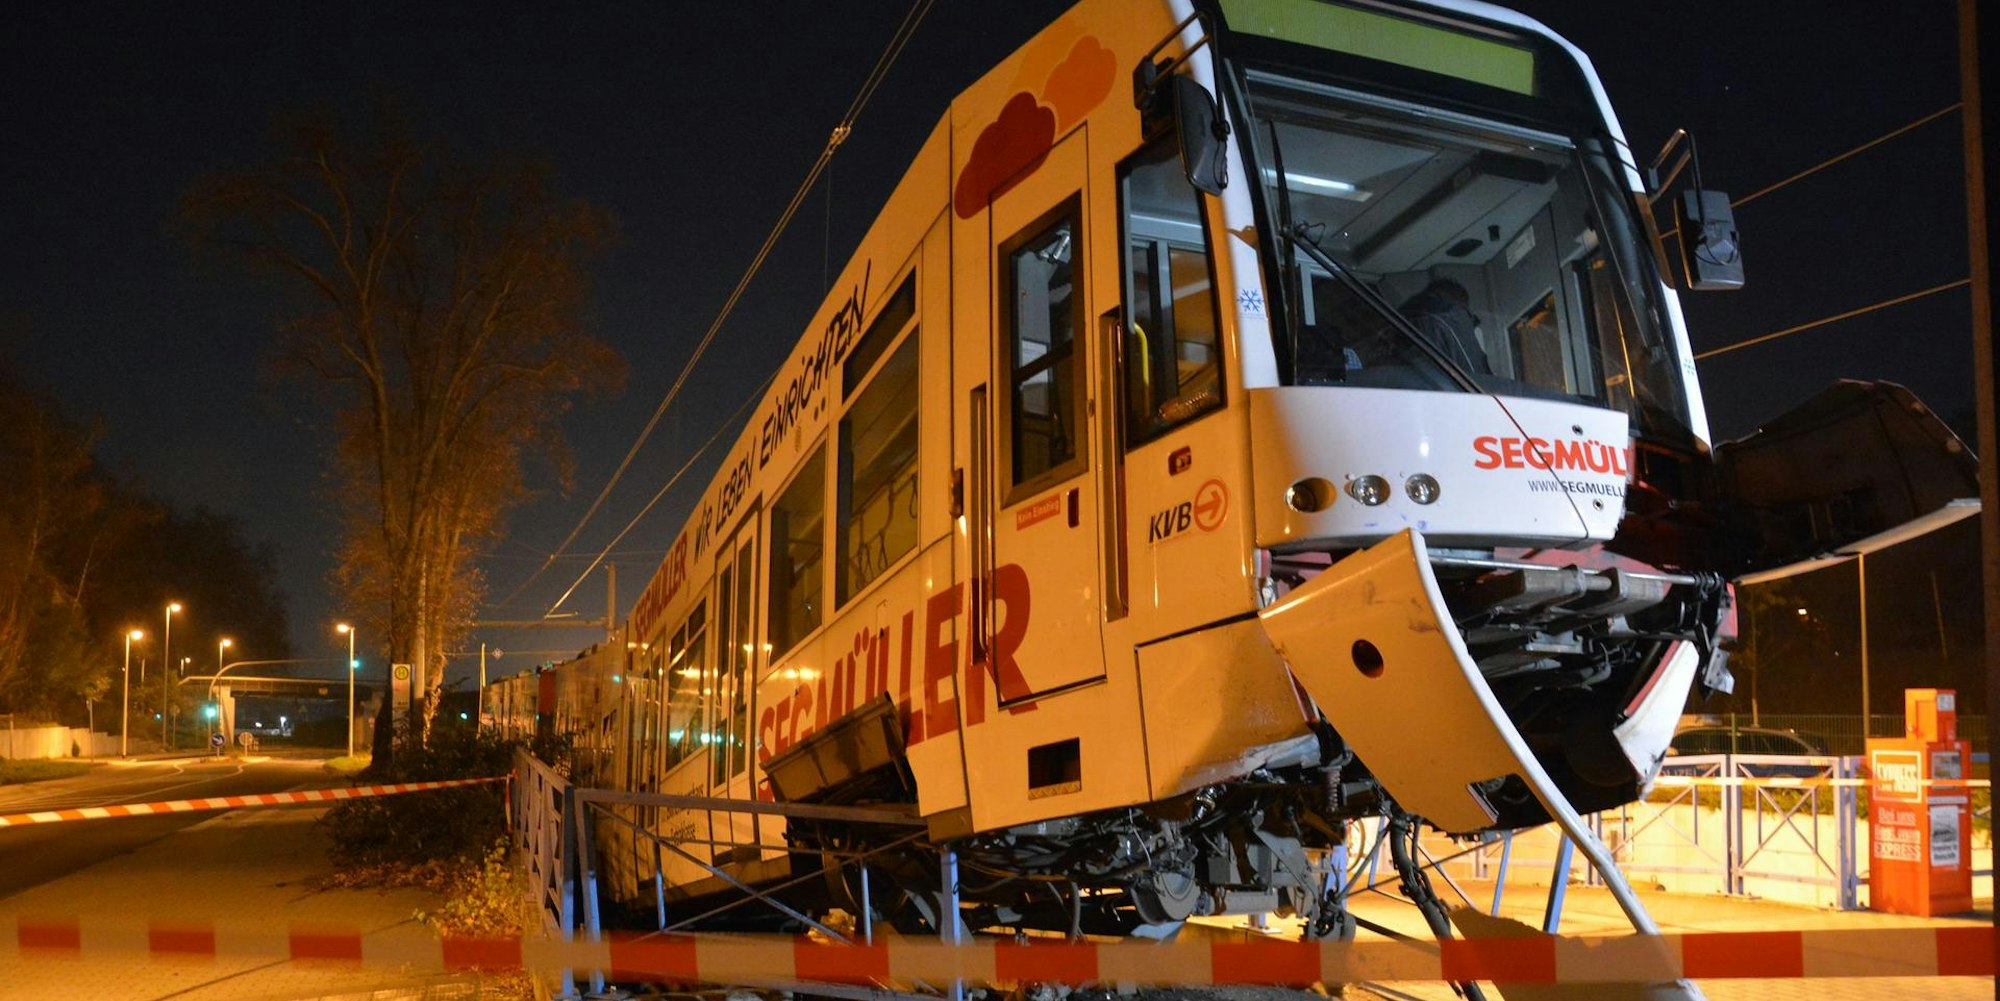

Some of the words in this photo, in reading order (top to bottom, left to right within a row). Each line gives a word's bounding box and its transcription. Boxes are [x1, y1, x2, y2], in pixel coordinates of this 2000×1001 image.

[635, 530, 688, 641] SEGMÜLLER
[714, 436, 756, 533] LEBEN
[1149, 501, 1192, 543] KVB
[1874, 842, 1921, 862] EXPRESS
